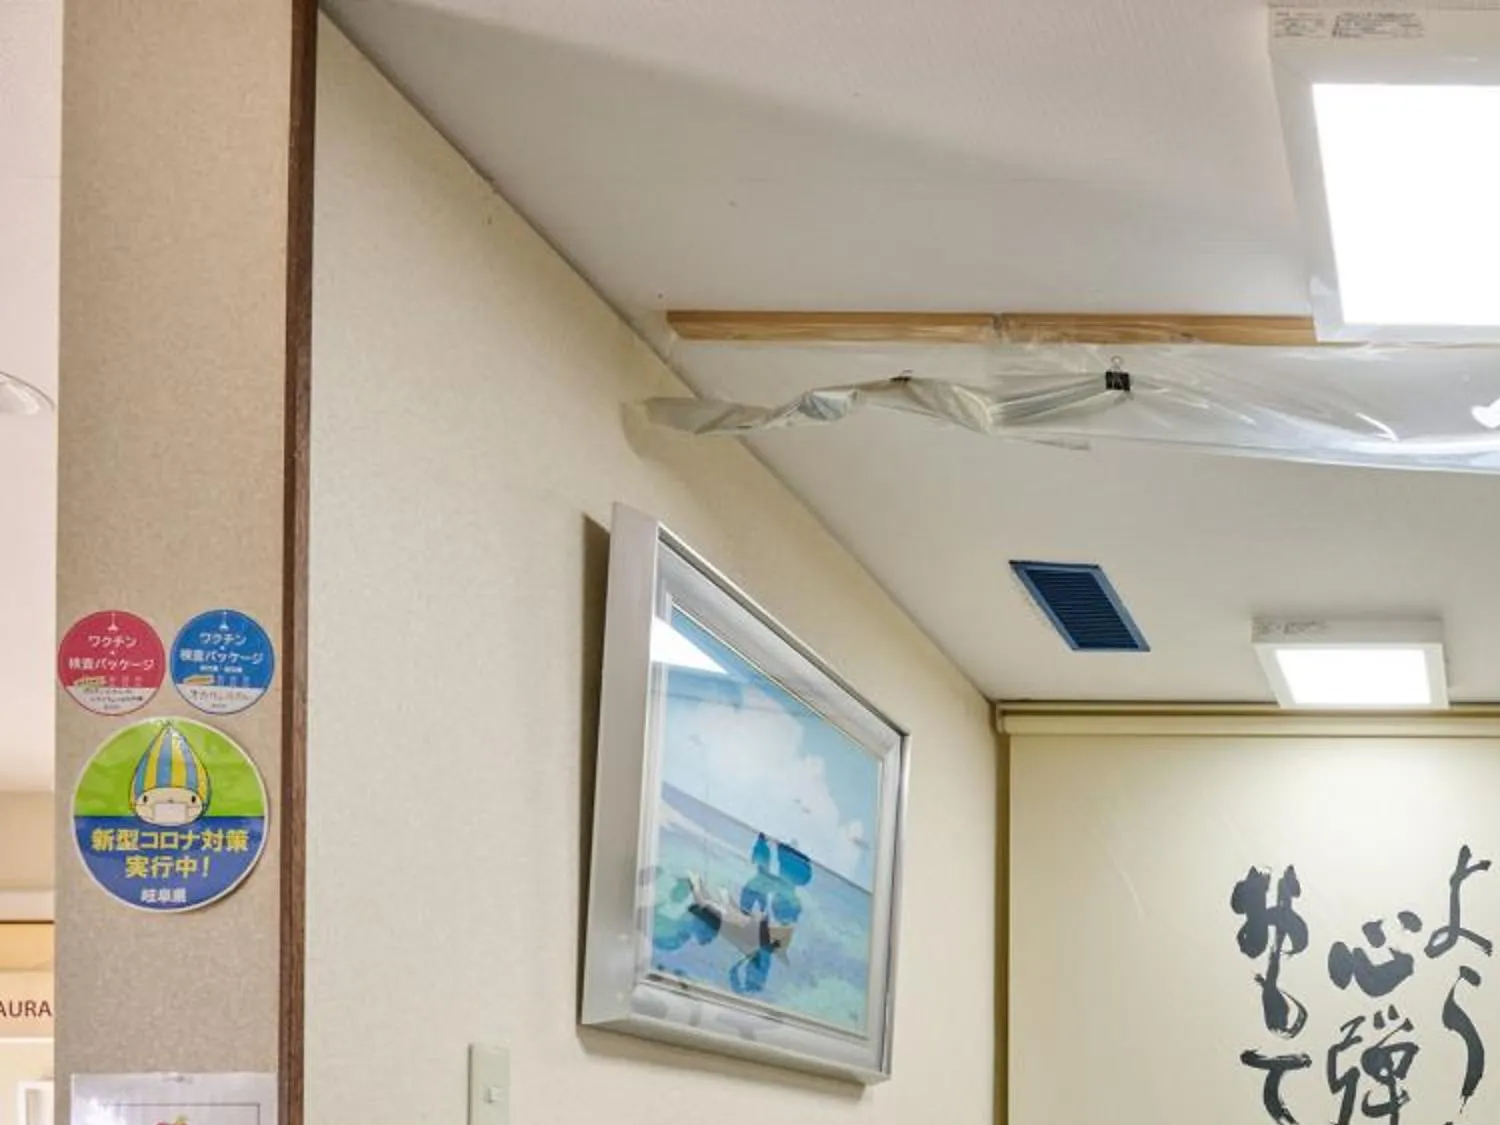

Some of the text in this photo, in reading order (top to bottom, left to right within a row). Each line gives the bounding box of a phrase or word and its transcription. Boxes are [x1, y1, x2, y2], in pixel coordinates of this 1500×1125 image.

[87, 635, 138, 649] ワクチン
[199, 632, 248, 646] ワクチン
[91, 829, 249, 852] 新型コロナ対策
